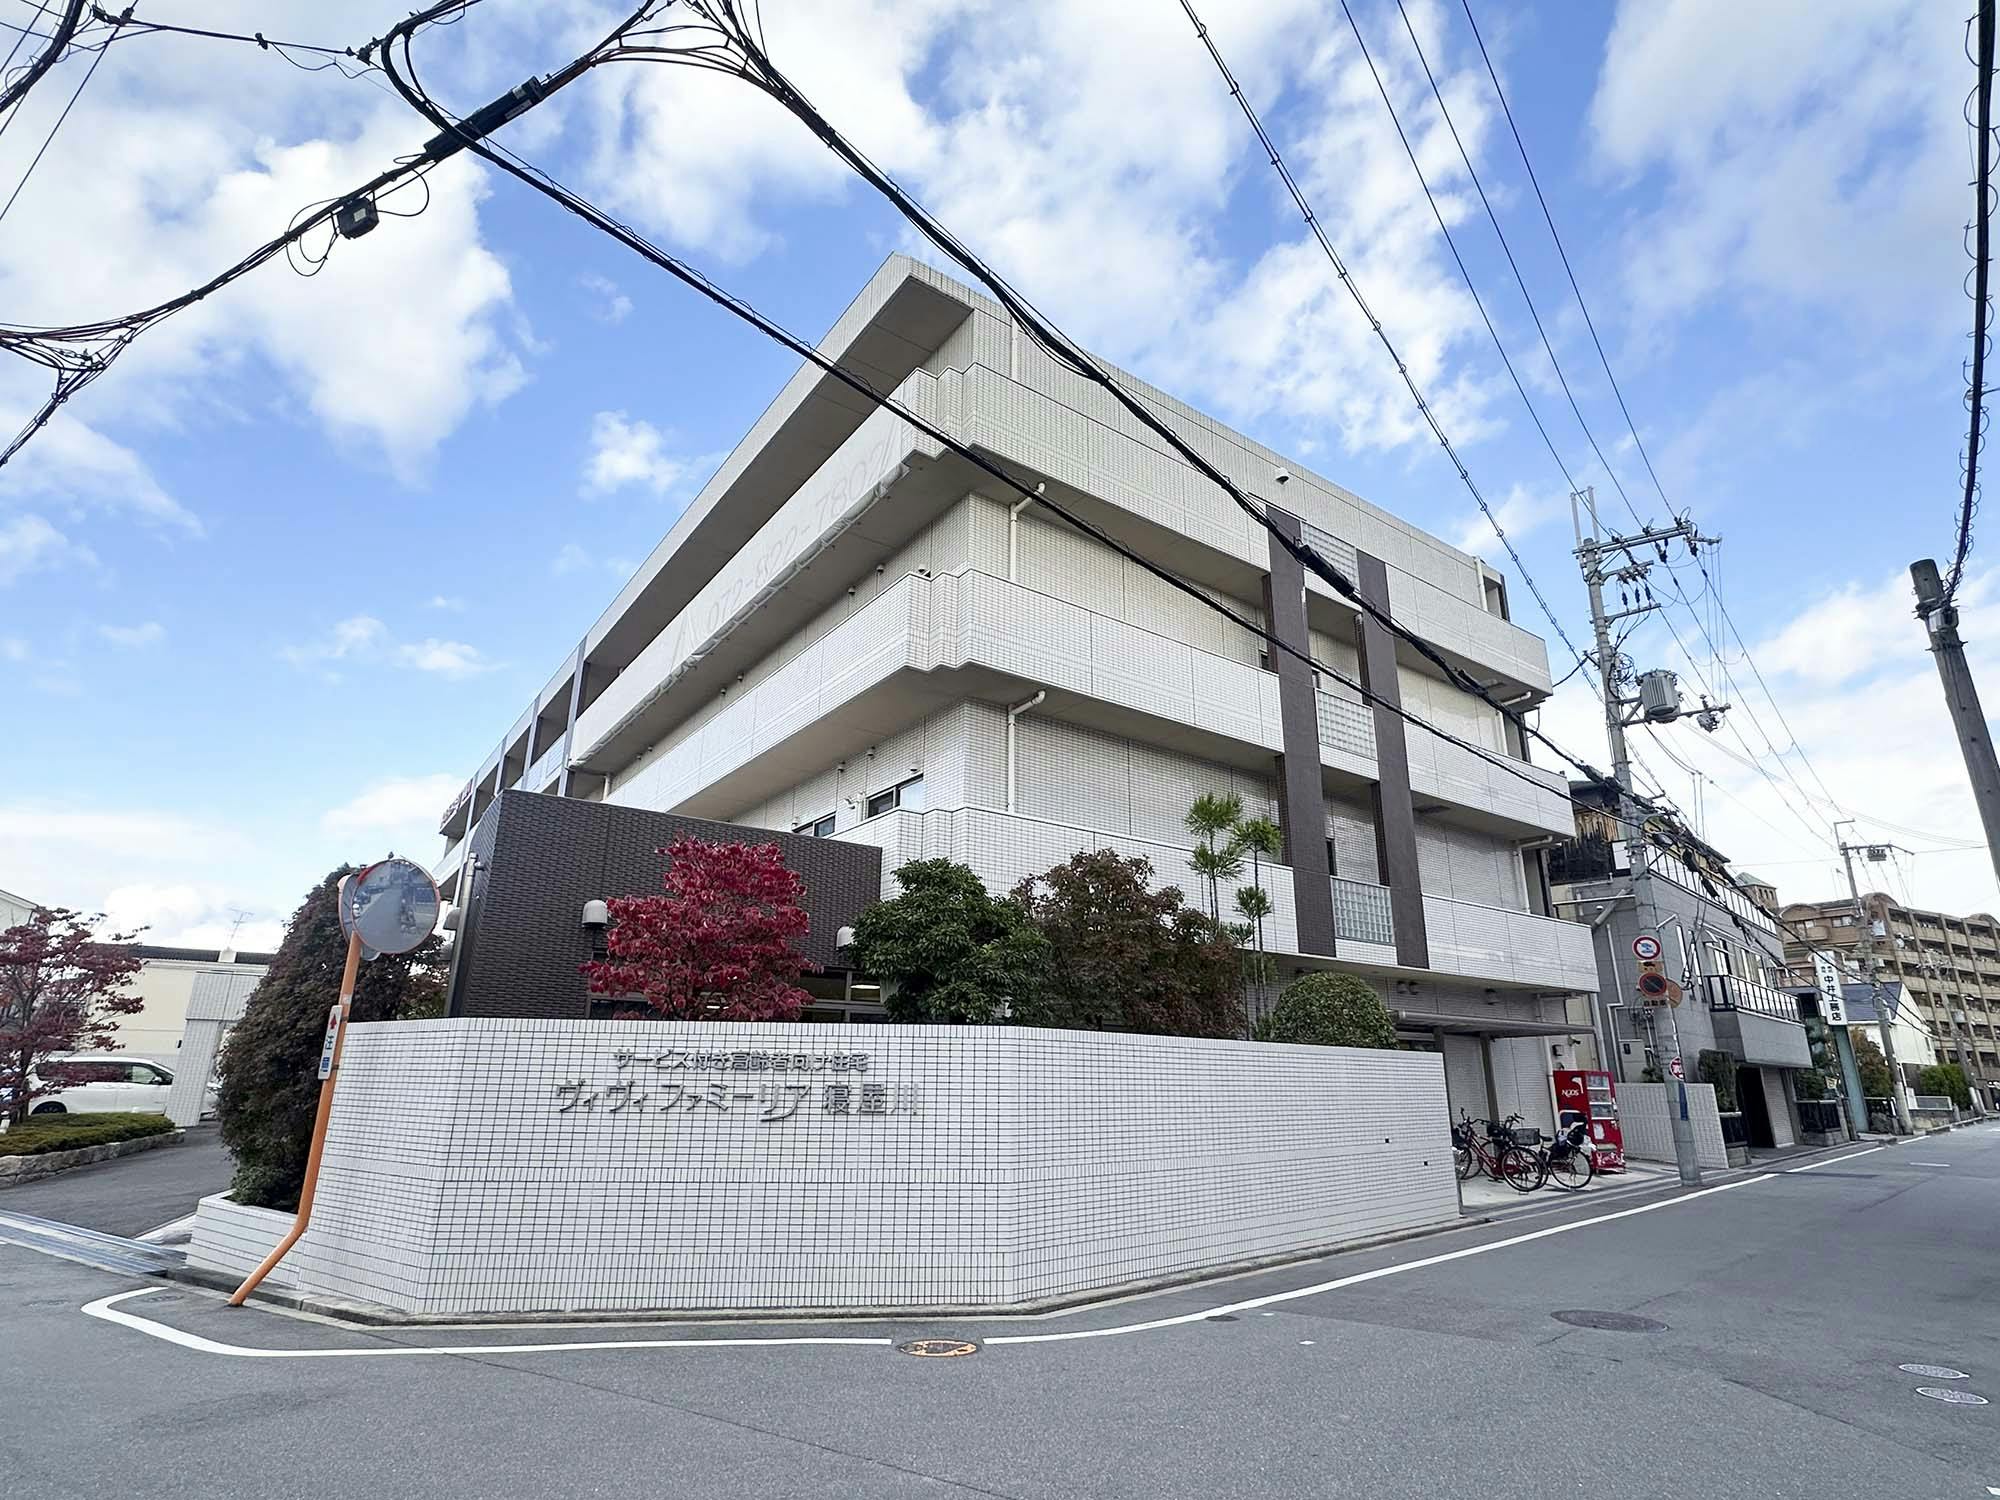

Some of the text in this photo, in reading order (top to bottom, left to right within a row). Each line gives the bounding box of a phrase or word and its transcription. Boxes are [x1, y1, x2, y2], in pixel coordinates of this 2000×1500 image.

[614, 1048, 869, 1072] サービス付き高齢者向け住宅
